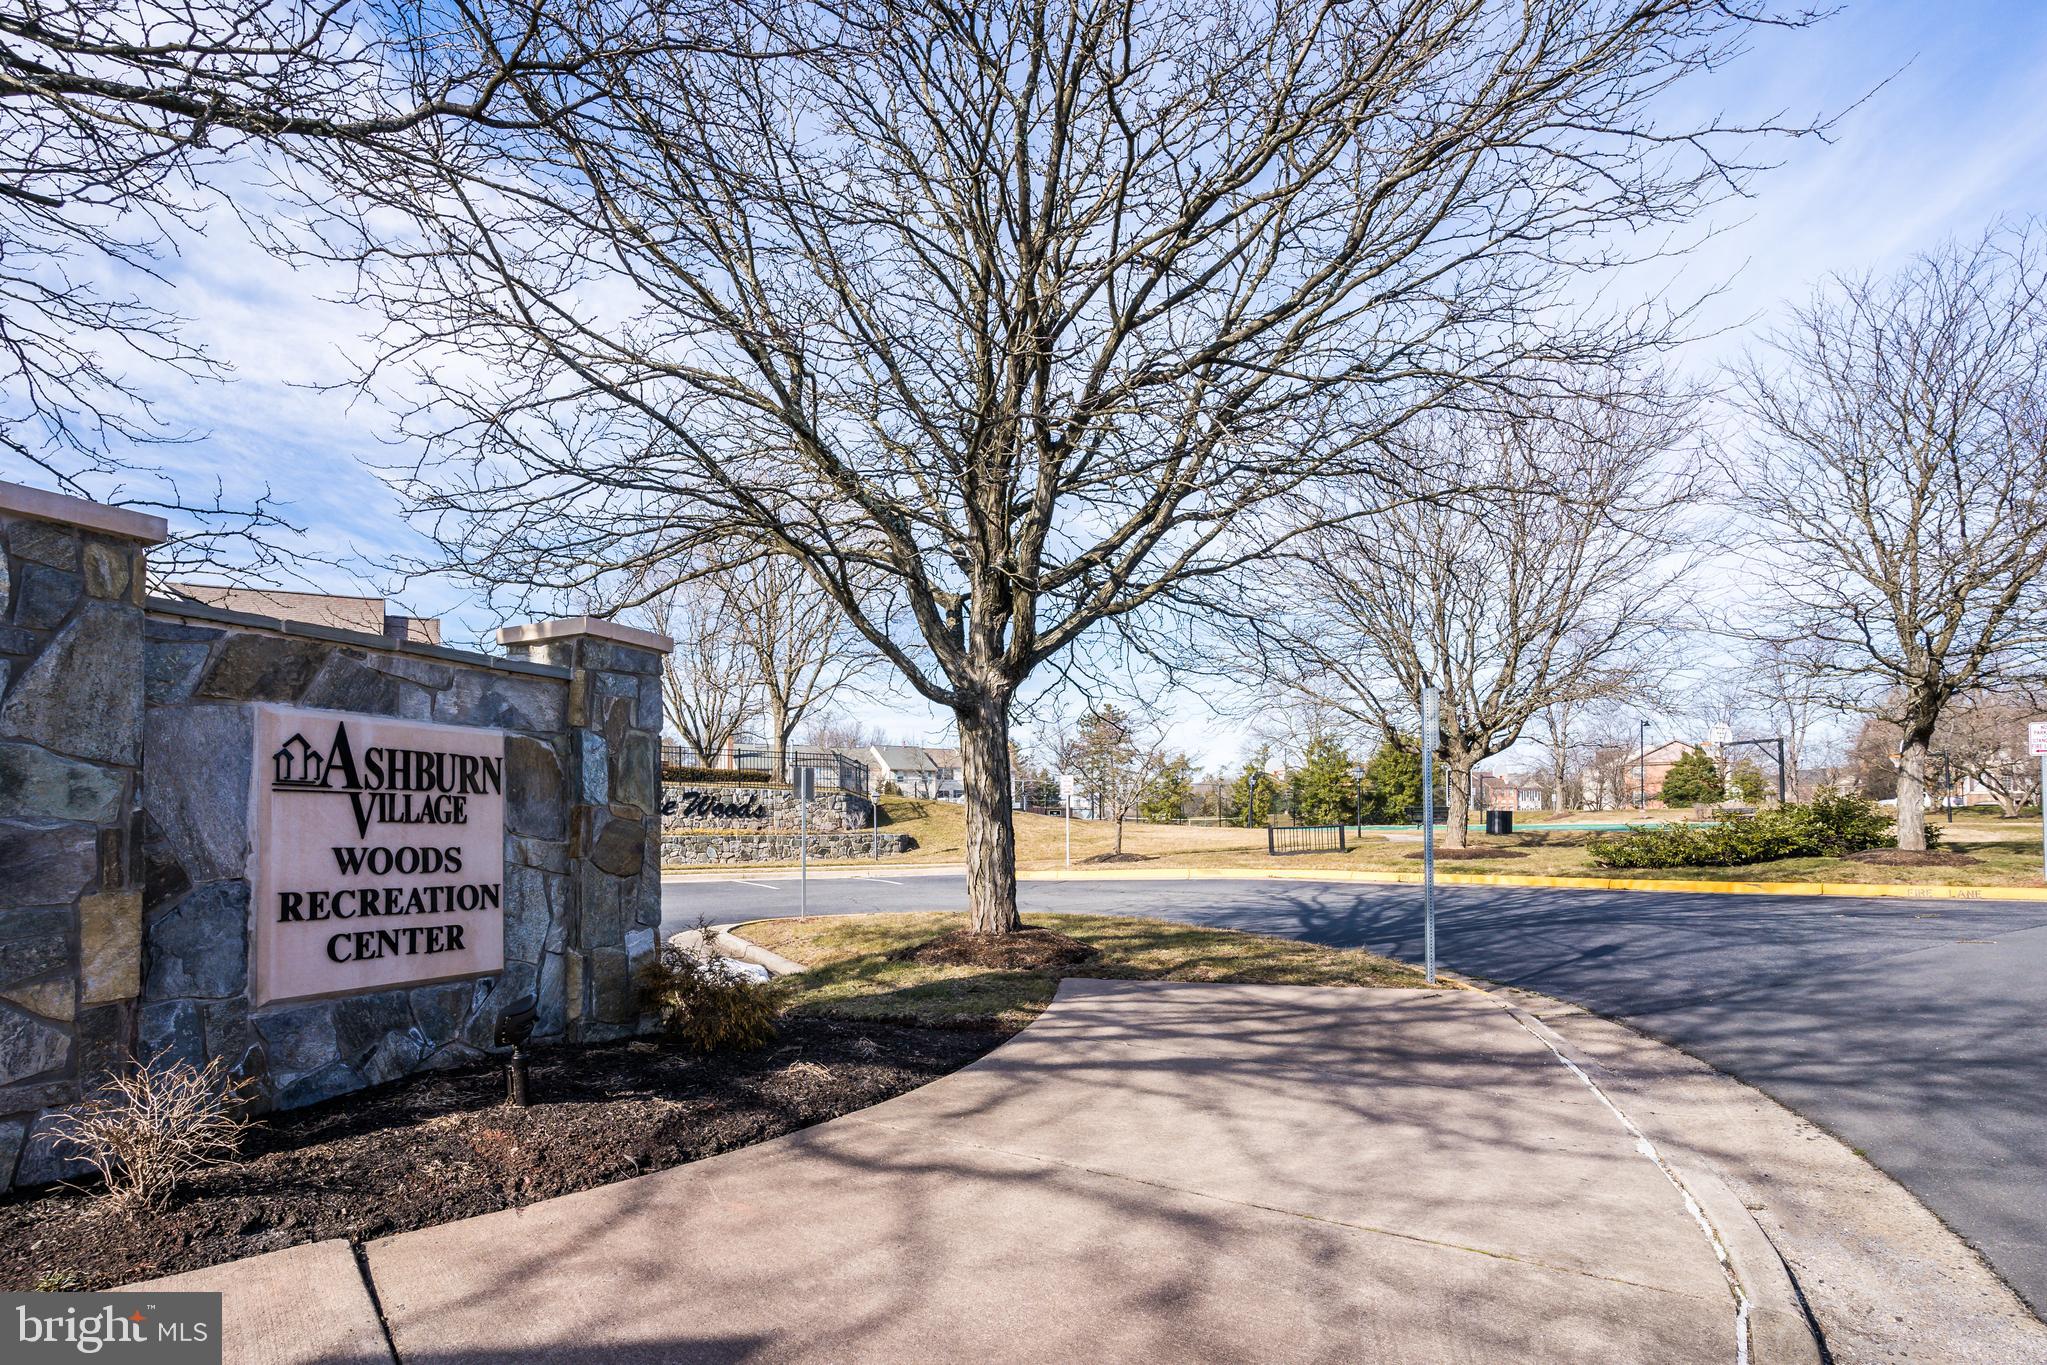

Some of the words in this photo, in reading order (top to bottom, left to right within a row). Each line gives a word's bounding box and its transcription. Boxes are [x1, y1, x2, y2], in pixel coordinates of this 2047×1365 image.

[320, 720, 504, 796] ASHBURN
[349, 791, 468, 840] VILLAGE
[683, 791, 766, 819] Woods
[331, 846, 463, 876] WOODS
[277, 883, 501, 923] RECREATION
[1907, 888, 1933, 897] FIRE
[1948, 889, 1983, 899] LANE
[326, 924, 467, 963] CENTER
